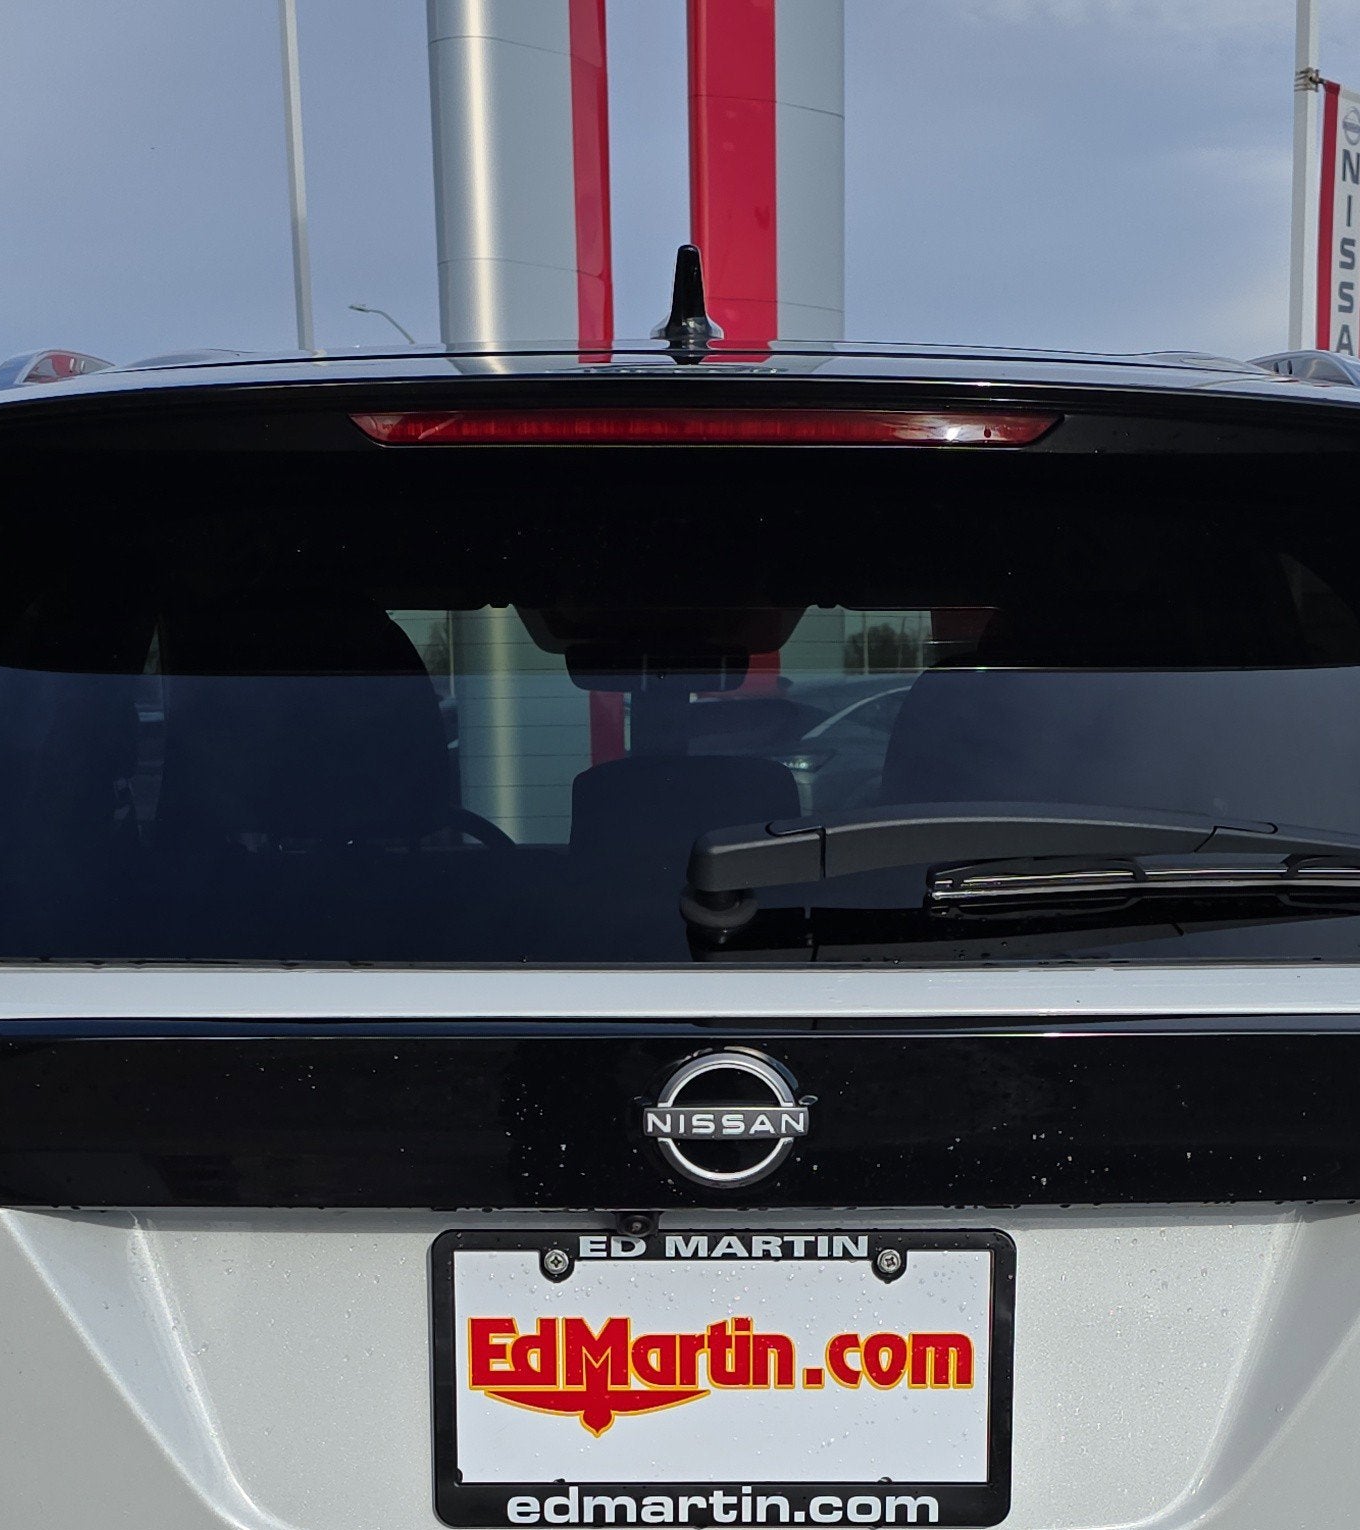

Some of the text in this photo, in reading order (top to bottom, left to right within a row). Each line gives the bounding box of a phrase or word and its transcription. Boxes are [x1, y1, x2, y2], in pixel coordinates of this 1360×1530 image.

[646, 1112, 805, 1135] NISSAN
[578, 1234, 870, 1259] ED MARTIN
[467, 1316, 975, 1391] EdMartin.com
[506, 1485, 940, 1524] edmartin.com
